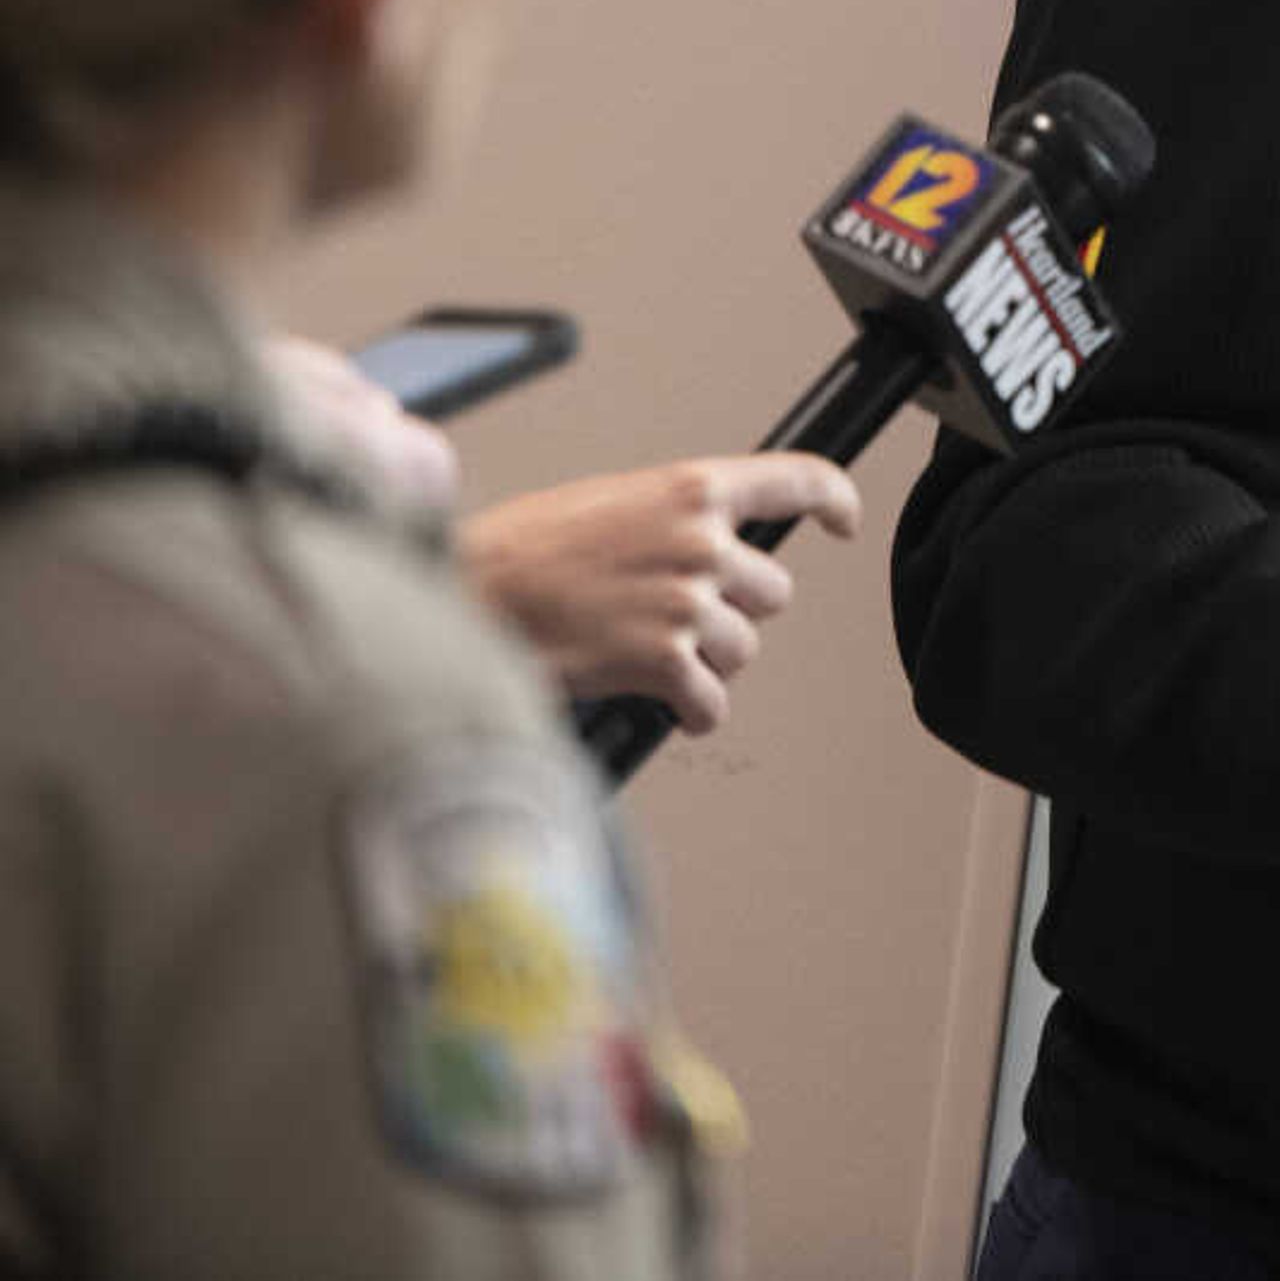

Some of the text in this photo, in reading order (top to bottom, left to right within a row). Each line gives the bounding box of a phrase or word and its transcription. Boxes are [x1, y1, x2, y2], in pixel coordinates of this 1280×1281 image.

[869, 145, 979, 230] 12
[944, 238, 1076, 432] NEWS
[1007, 207, 1112, 360] Heartland
